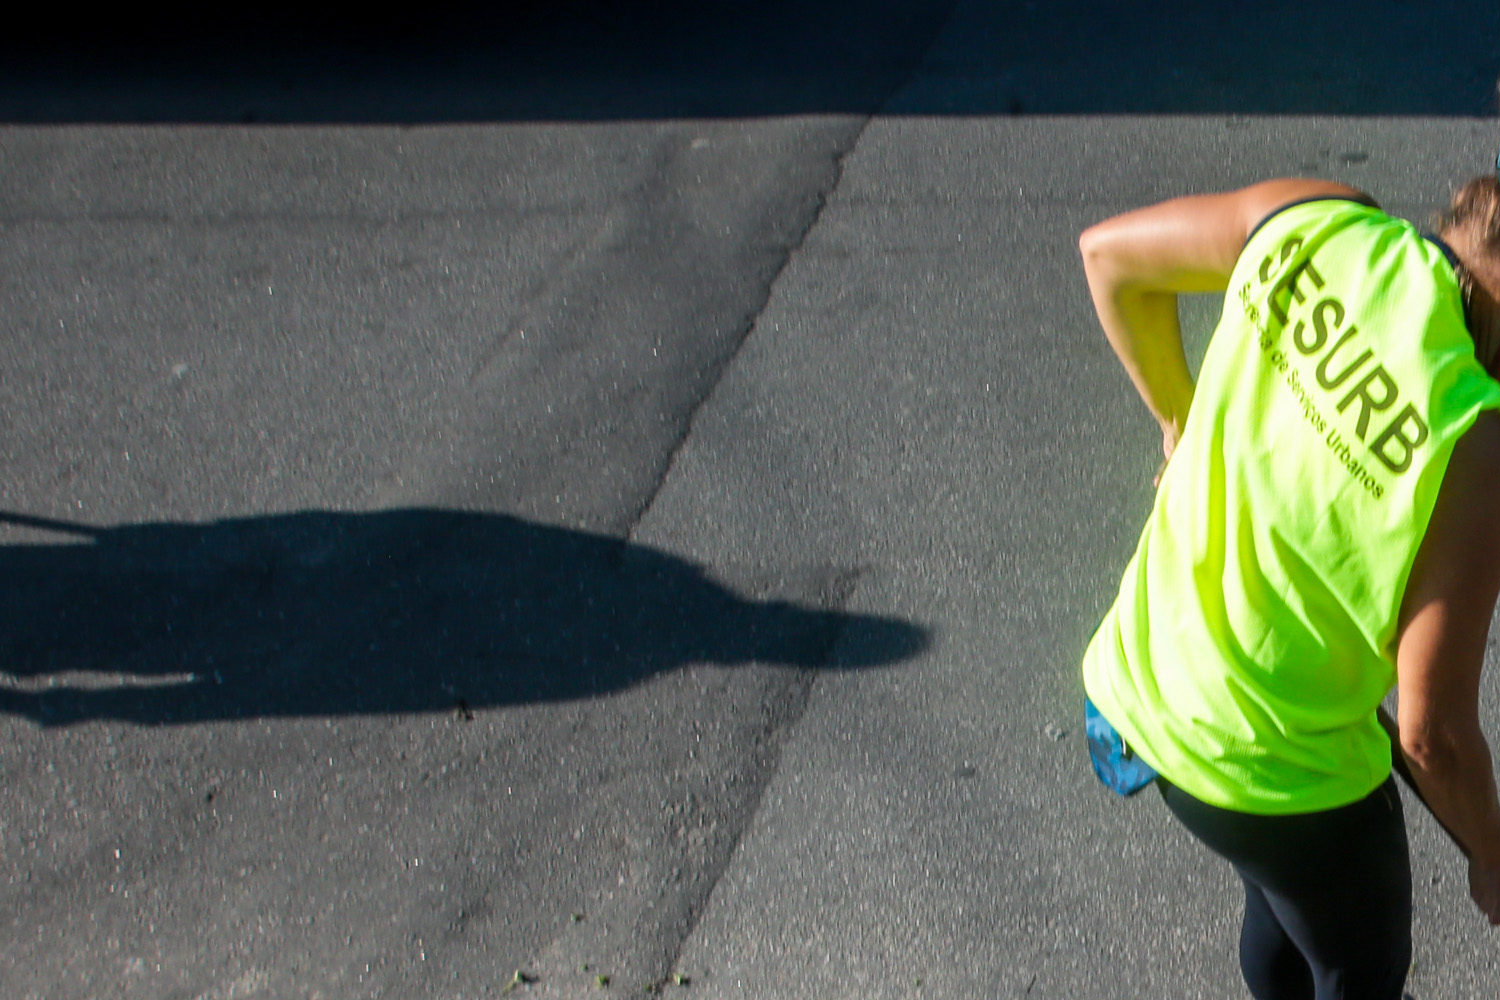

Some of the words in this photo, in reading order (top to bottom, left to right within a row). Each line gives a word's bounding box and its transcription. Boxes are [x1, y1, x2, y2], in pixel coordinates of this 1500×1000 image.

[1238, 282, 1273, 351] Secreria
[1271, 350, 1289, 374] de
[1287, 368, 1327, 433] Serviços
[1326, 428, 1384, 499] Urbanos
[1258, 238, 1429, 474] SESURB
